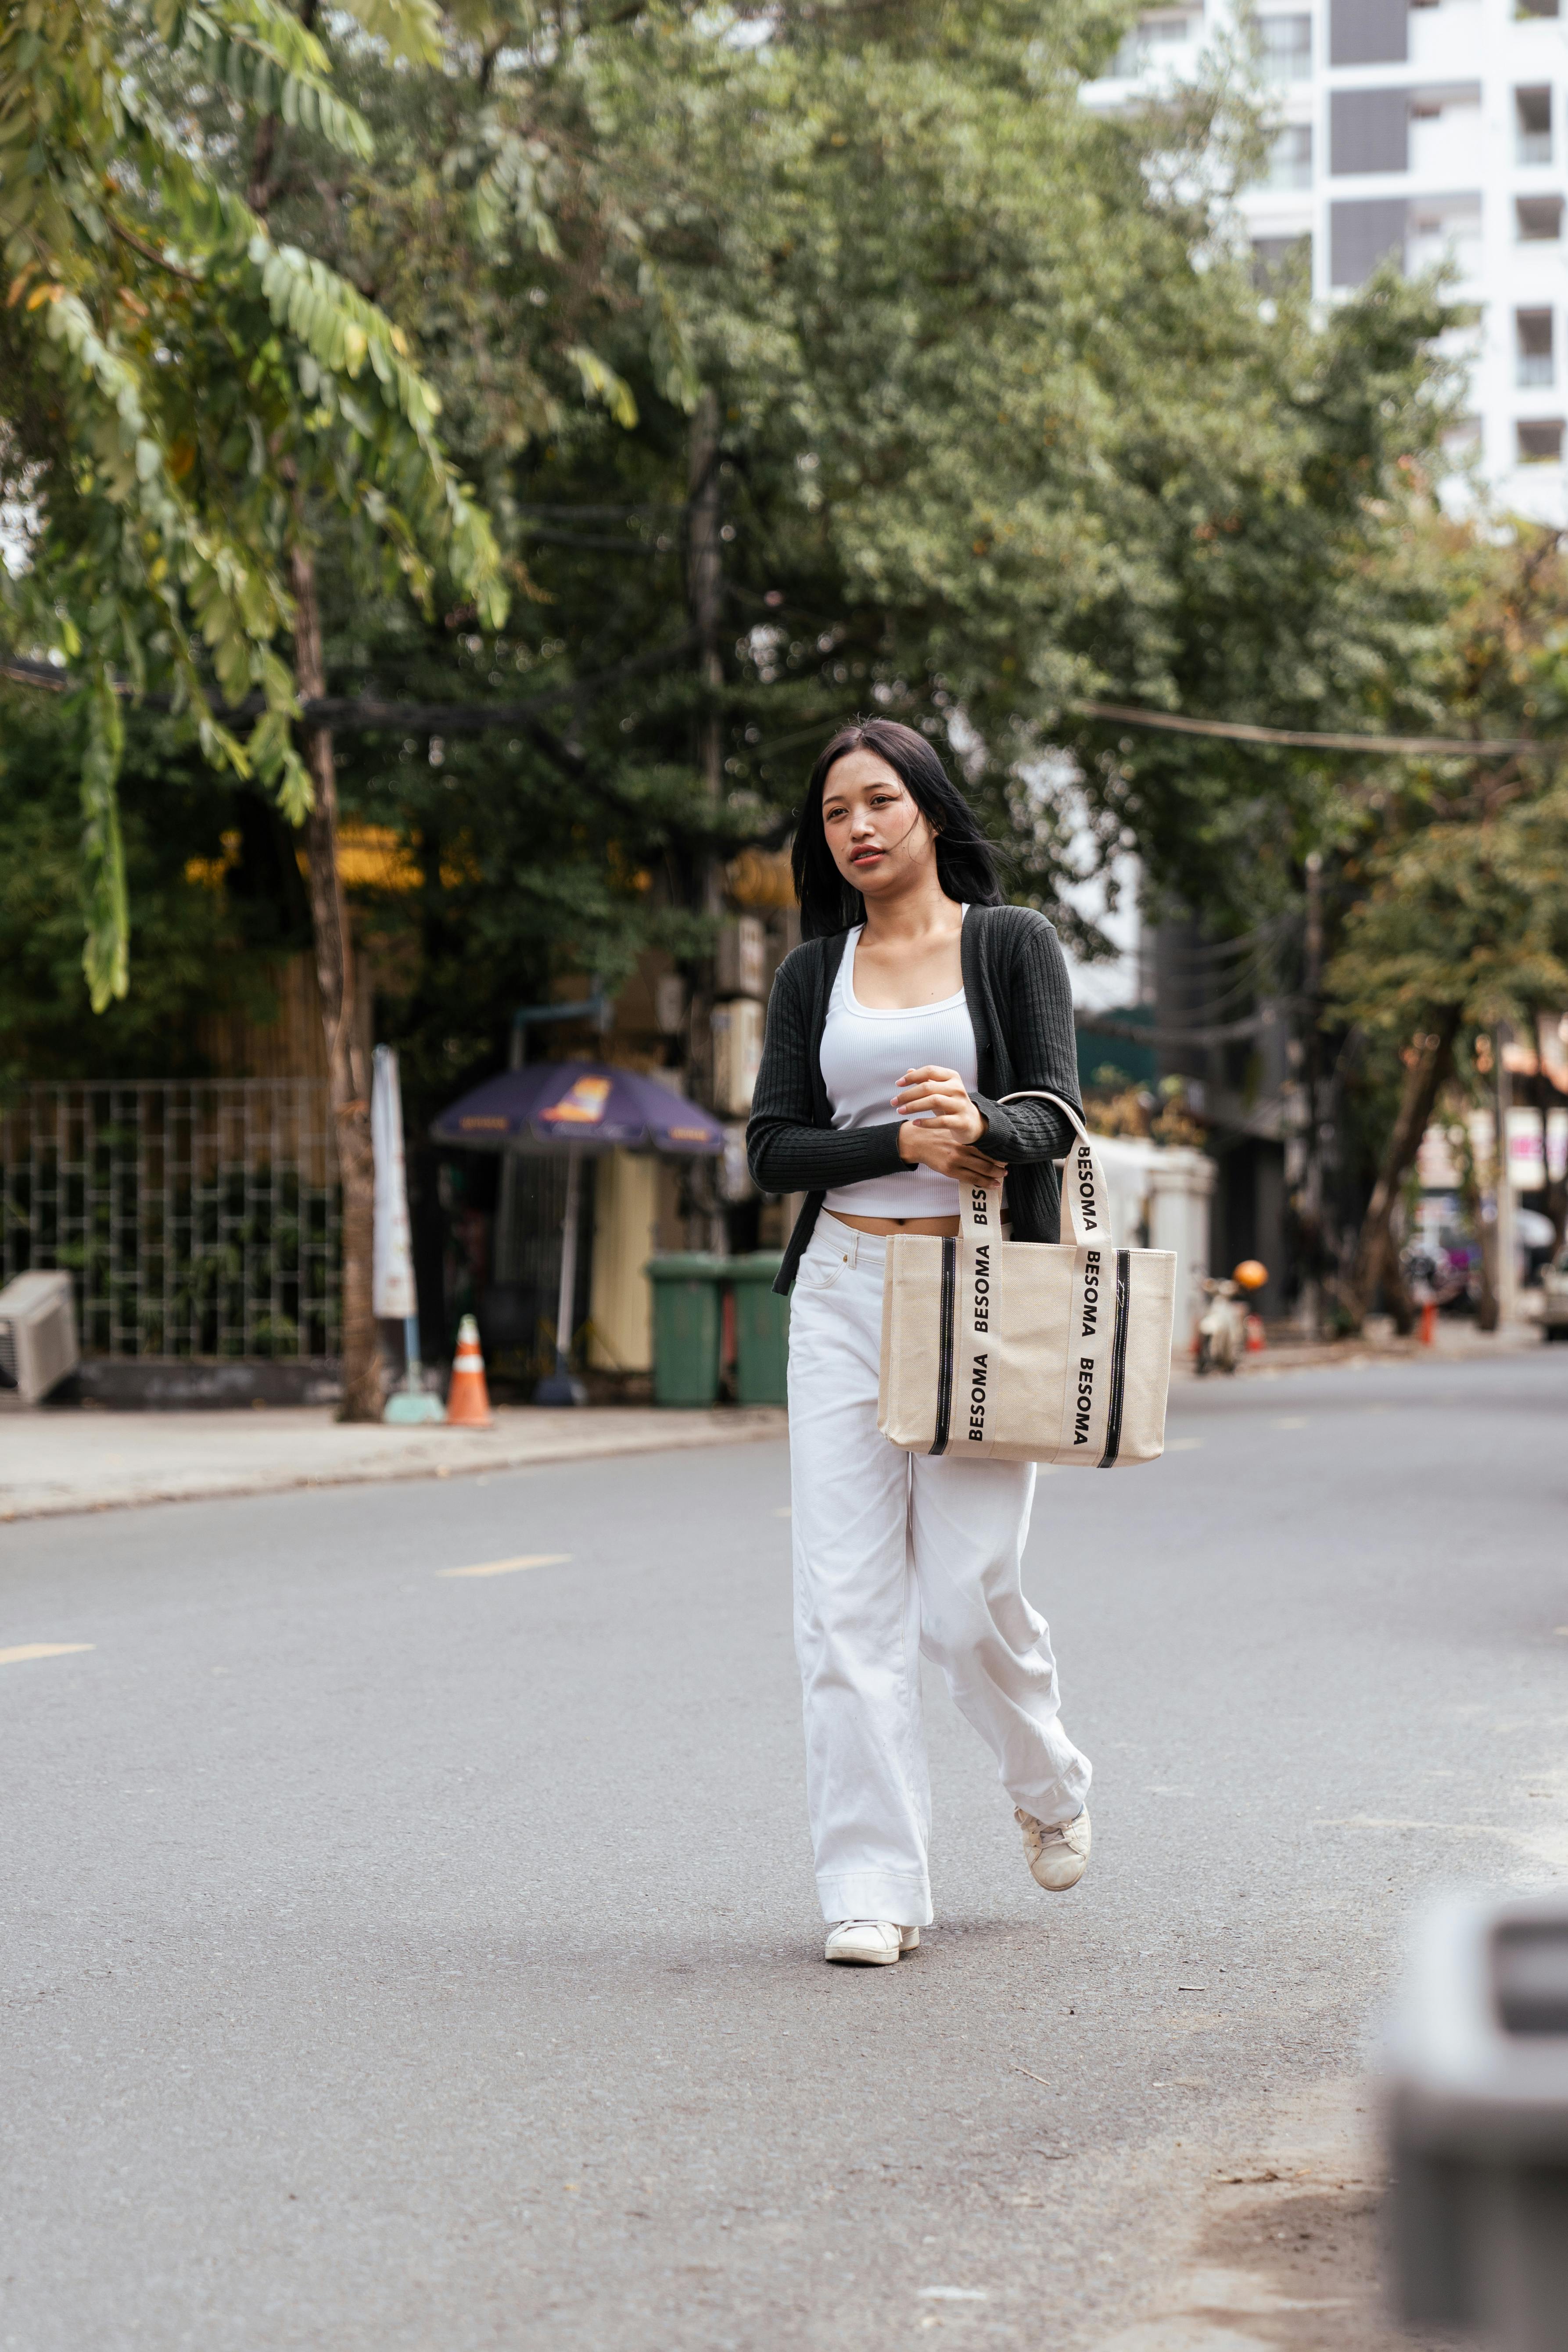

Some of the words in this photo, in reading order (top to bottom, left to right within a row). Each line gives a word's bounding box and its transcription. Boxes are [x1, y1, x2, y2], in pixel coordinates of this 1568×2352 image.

[972, 1184, 987, 1225] BES
[1077, 1146, 1097, 1231] BESOMA
[974, 1245, 990, 1333] BESOMA
[1082, 1251, 1101, 1337] BESOMA
[968, 1354, 988, 1441] BESOMA
[1073, 1357, 1094, 1445] BESOMA
